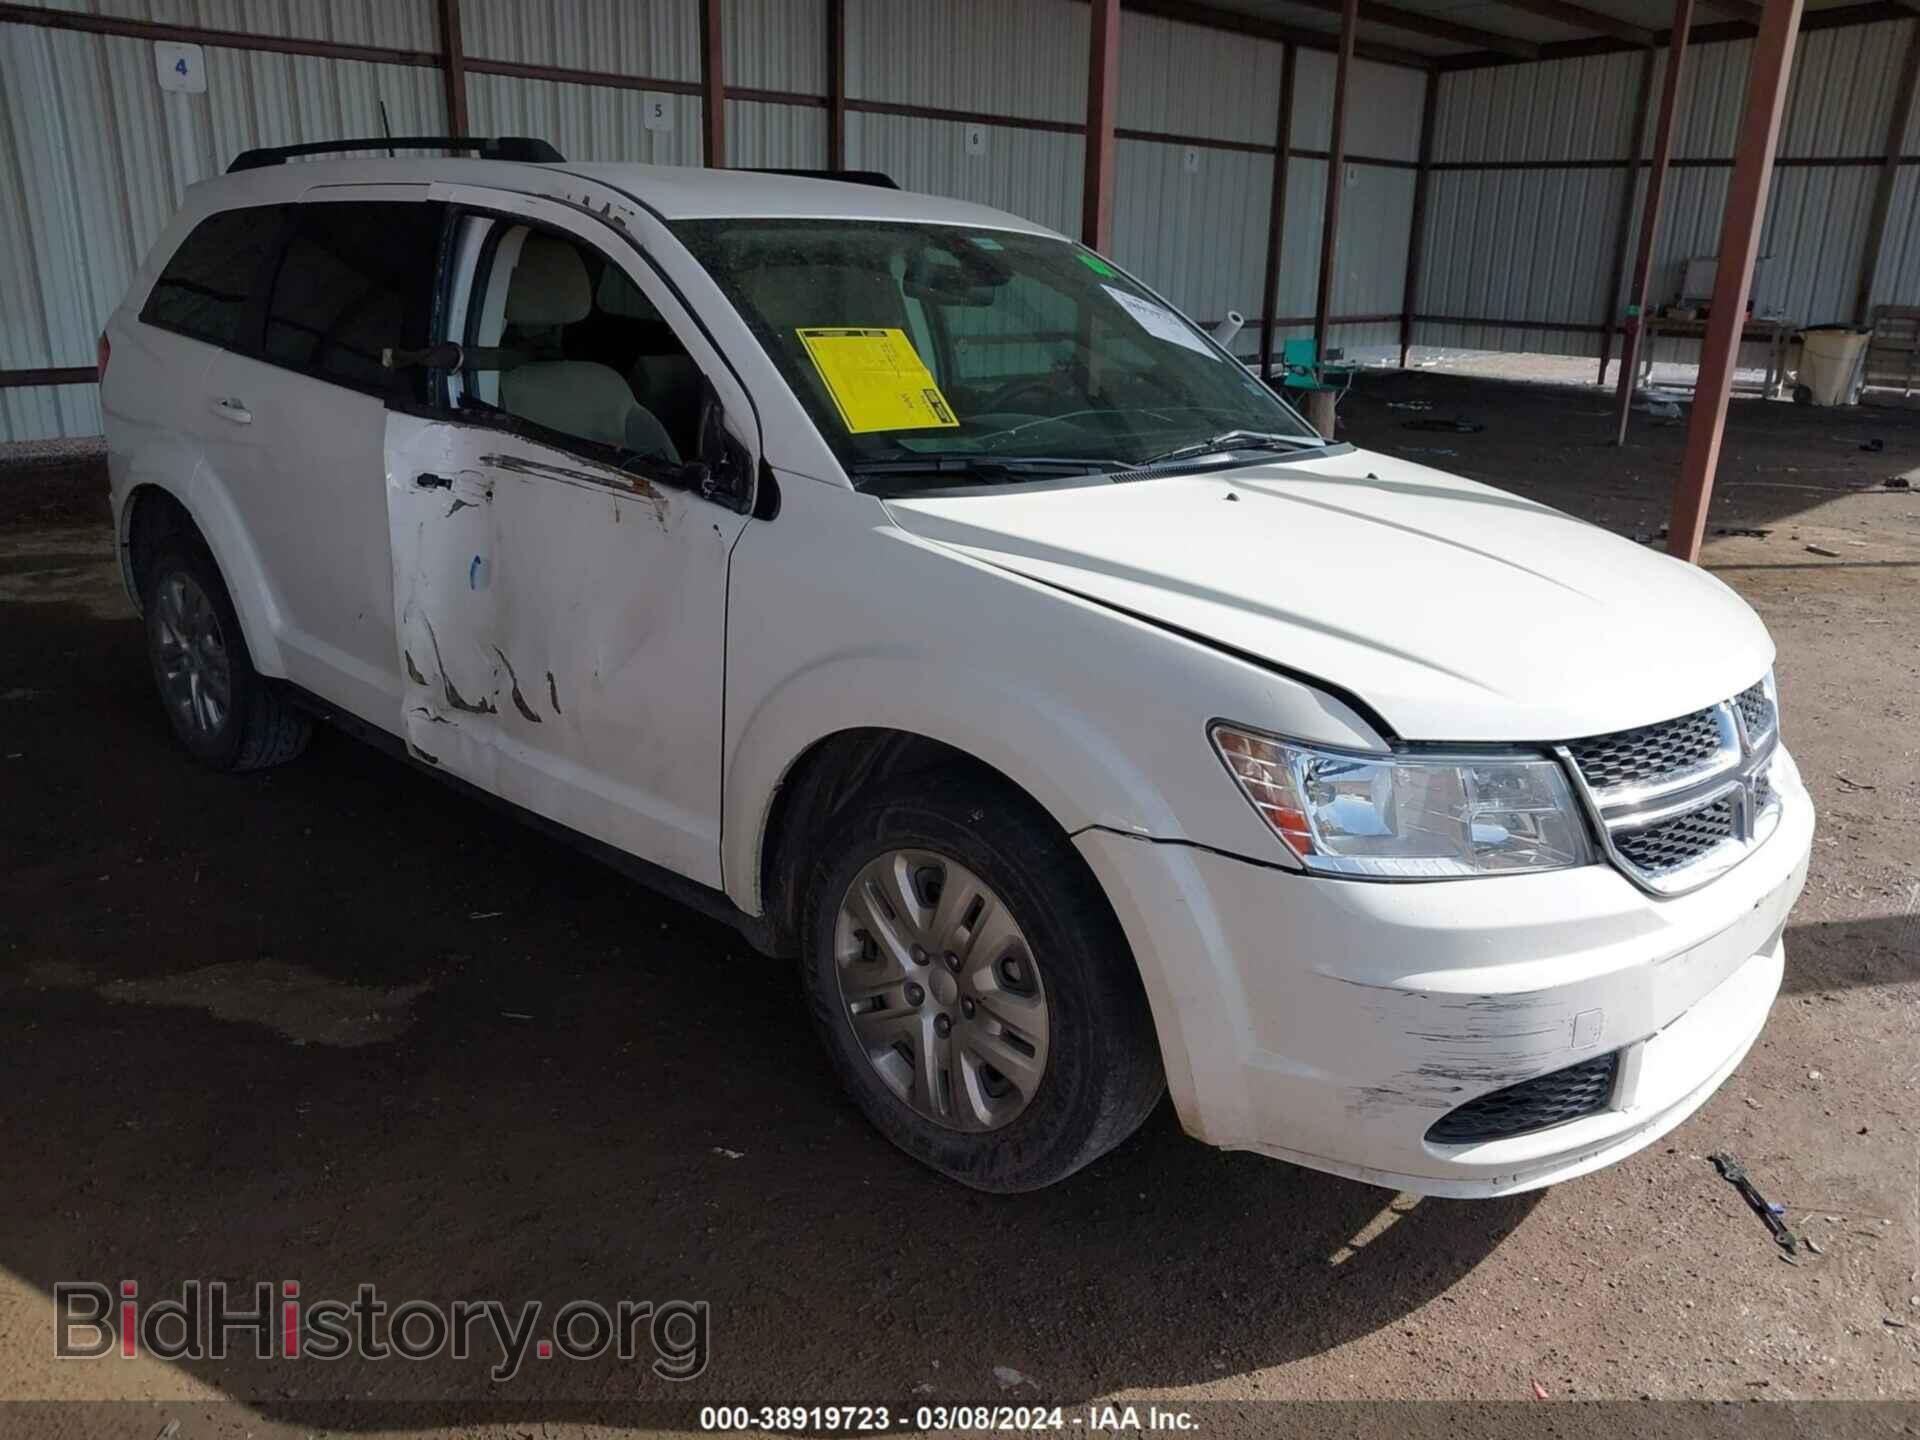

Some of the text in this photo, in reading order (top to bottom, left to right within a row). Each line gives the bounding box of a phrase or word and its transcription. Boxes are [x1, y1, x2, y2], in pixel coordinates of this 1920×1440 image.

[175, 57, 188, 76] 4
[655, 103, 663, 118] 5
[972, 133, 979, 145] 6
